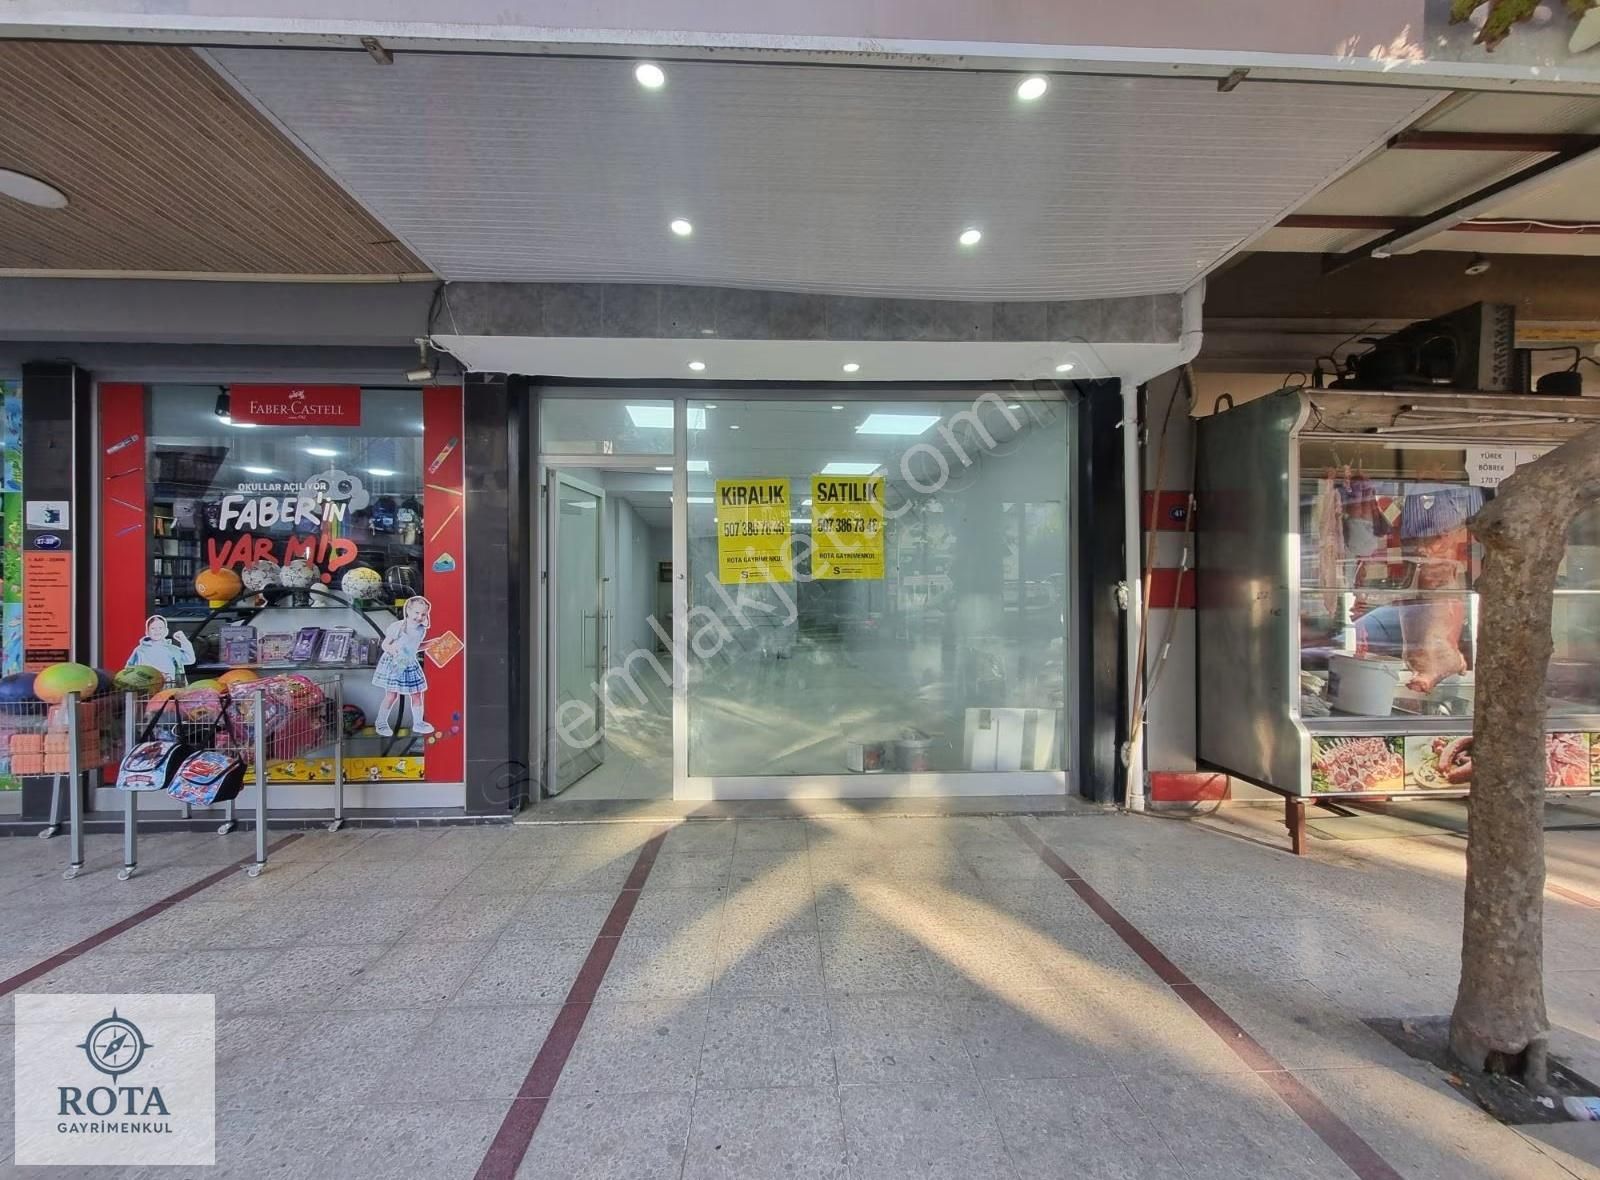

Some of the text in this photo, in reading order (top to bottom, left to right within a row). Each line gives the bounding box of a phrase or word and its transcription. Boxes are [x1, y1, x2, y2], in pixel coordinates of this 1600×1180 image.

[250, 400, 344, 415] FABER-CASTELL
[238, 482, 326, 492] OKULLAR AÇILIYOR
[817, 482, 878, 502] SATILIK
[724, 522, 739, 537] 507
[817, 518, 834, 533] 507
[835, 518, 852, 532] 386
[854, 518, 865, 532] 73
[207, 532, 279, 574] VAR
